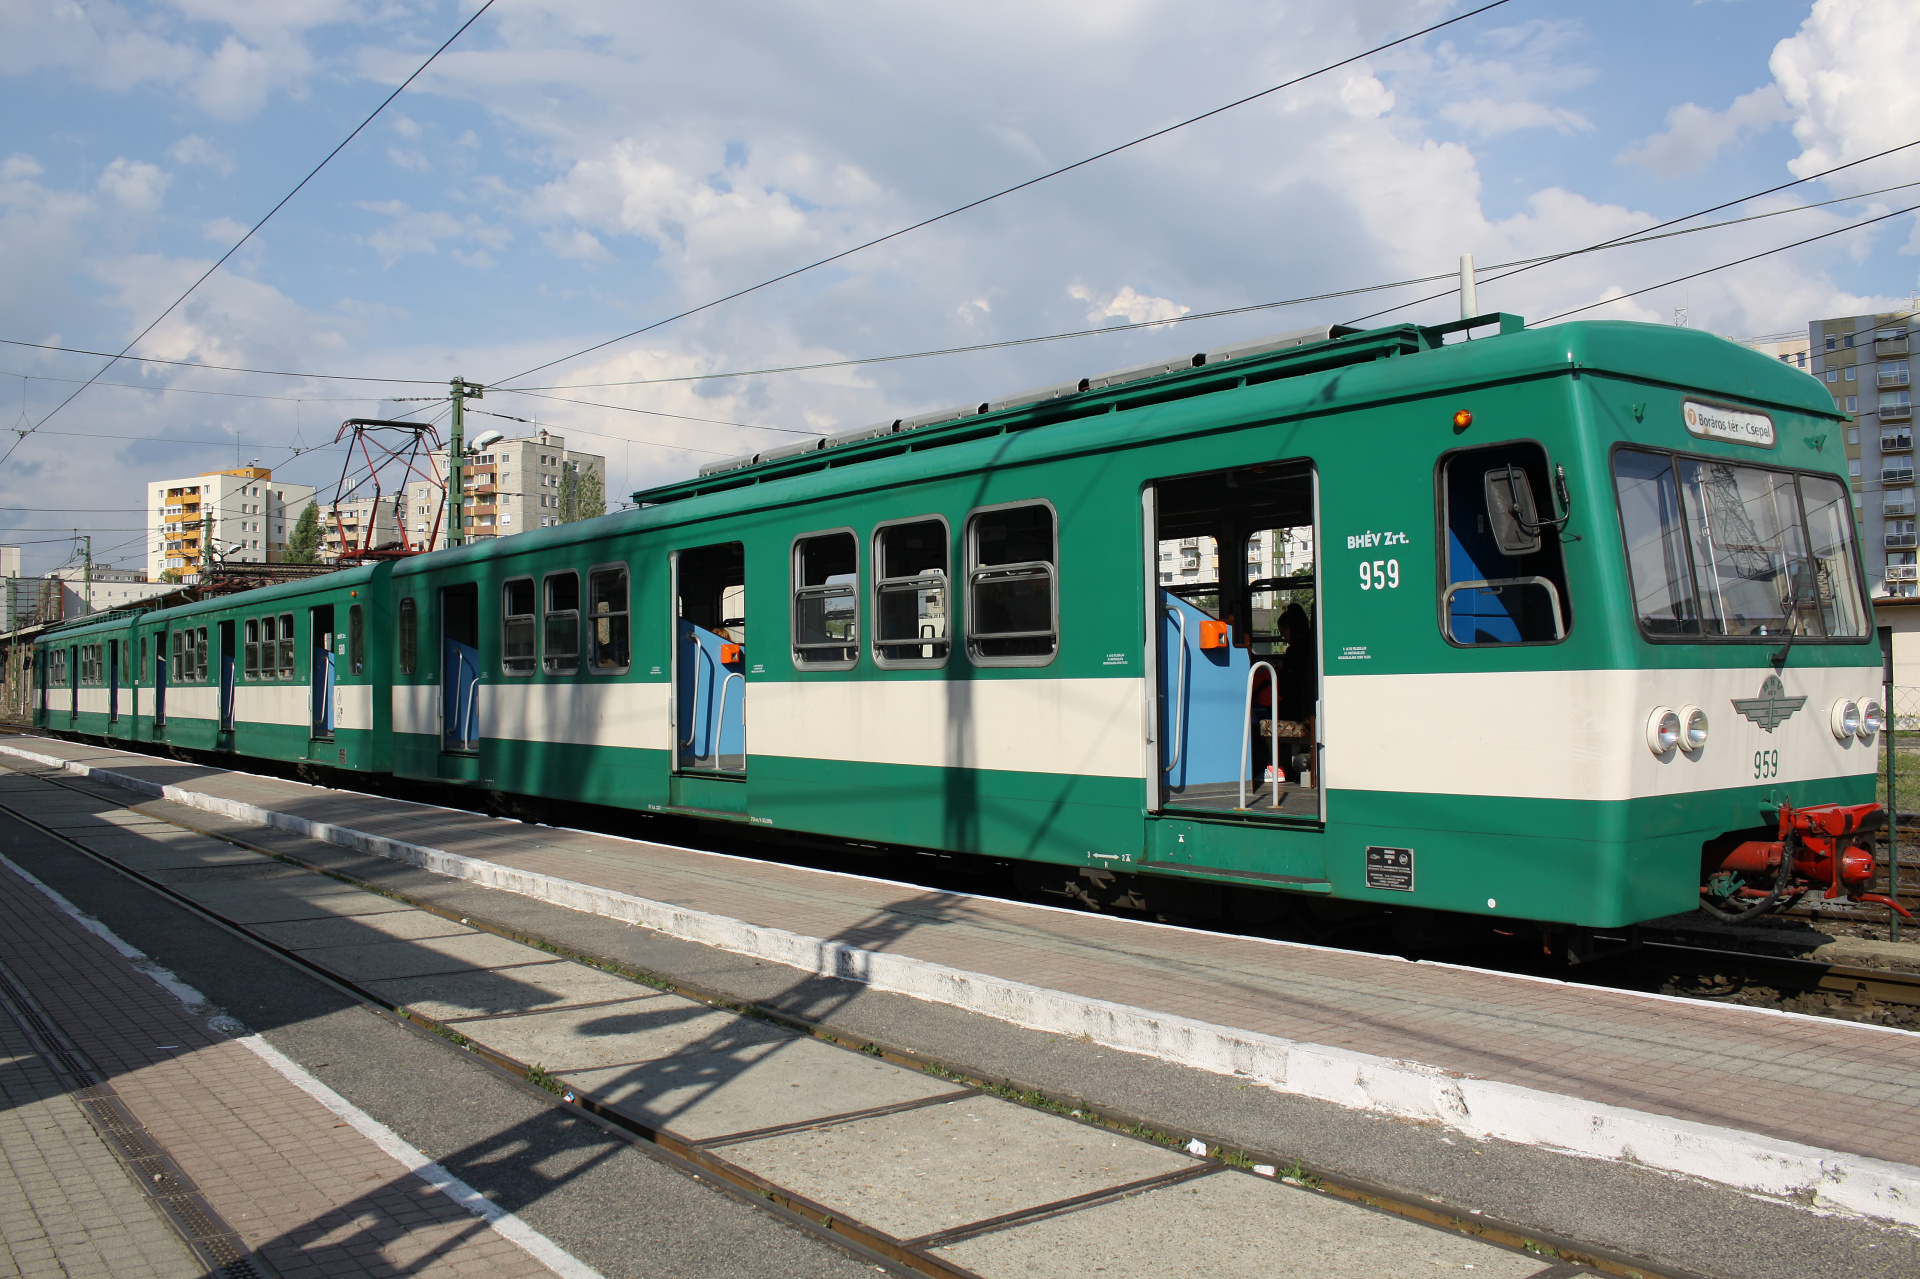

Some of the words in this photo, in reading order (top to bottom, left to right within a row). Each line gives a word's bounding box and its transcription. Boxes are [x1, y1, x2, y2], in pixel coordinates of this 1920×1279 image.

[1698, 414, 1727, 430] Boráros
[1727, 420, 1739, 433] tér
[1745, 422, 1771, 439] Csepel
[1347, 530, 1382, 550] BHÉV
[1384, 531, 1410, 546] Zrt.
[1359, 558, 1400, 591] 959
[1754, 749, 1778, 780] 959
